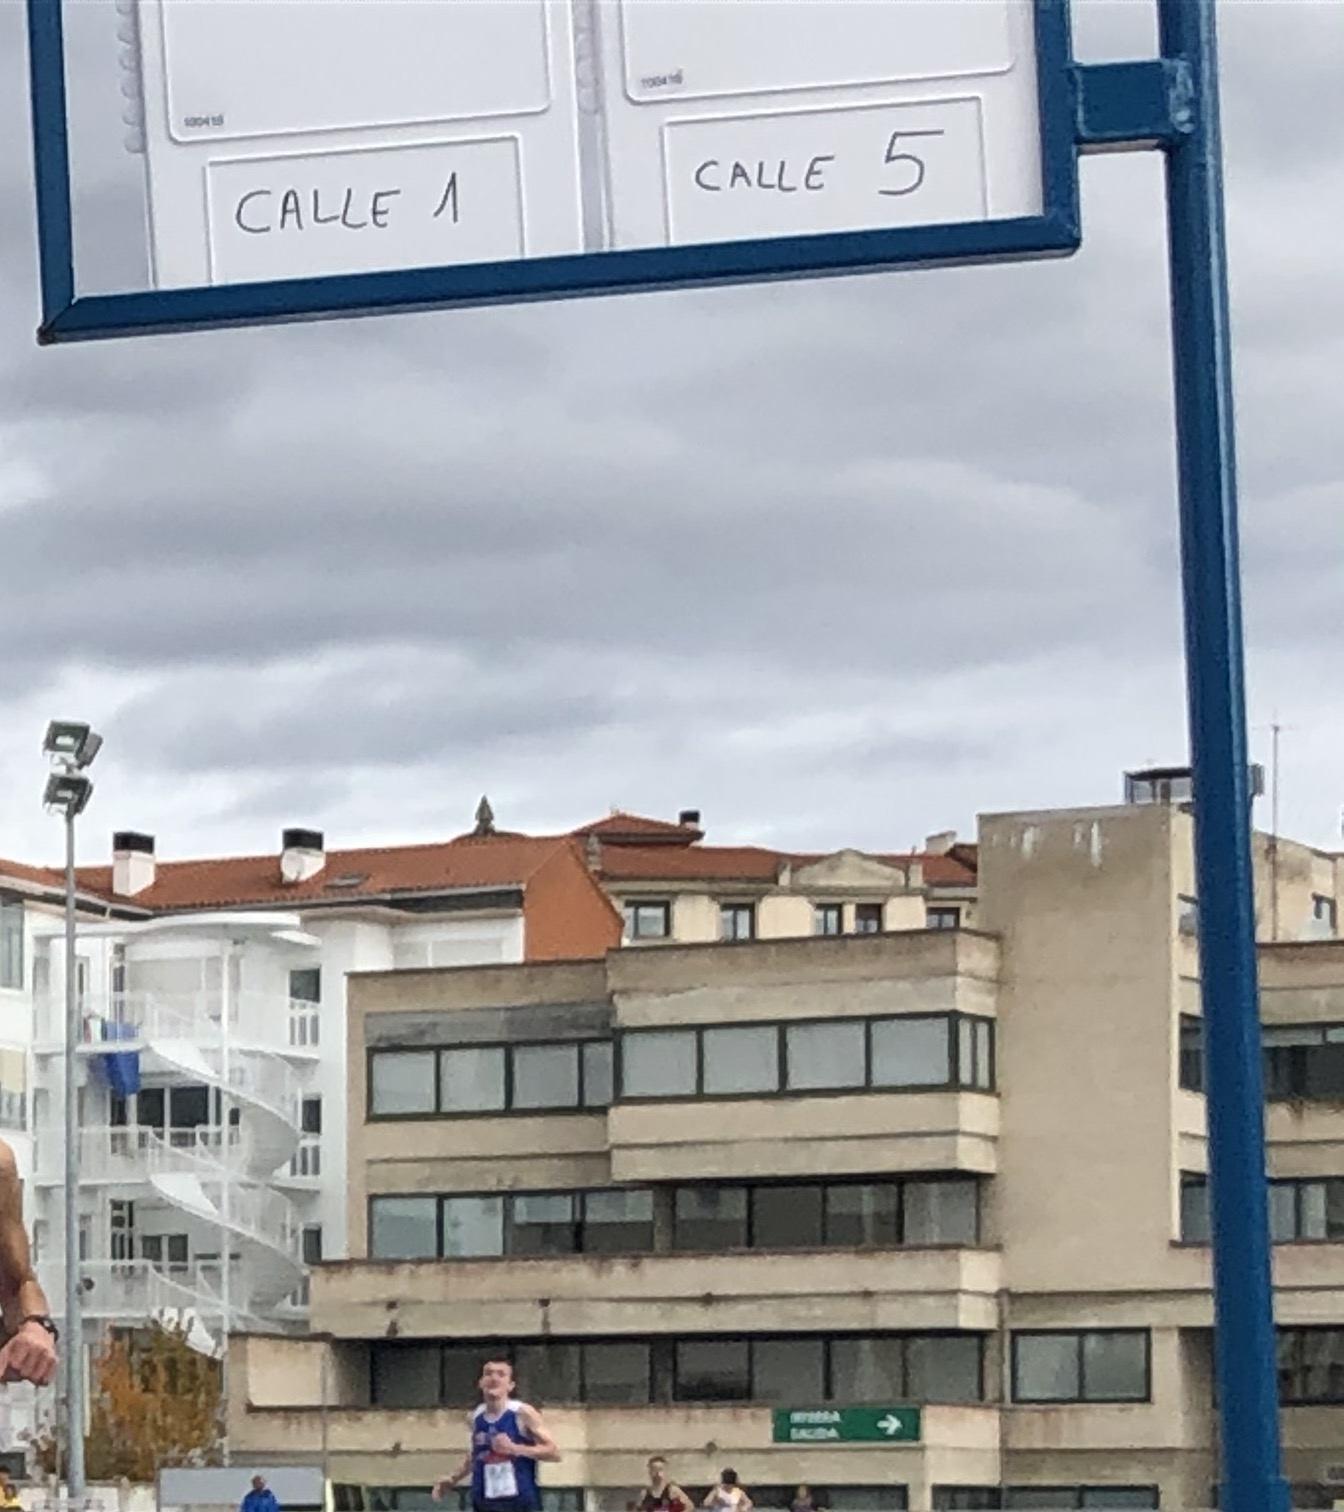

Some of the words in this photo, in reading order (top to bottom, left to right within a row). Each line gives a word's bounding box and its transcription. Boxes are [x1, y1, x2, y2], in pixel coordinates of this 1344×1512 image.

[694, 154, 836, 192] CALLE
[878, 128, 945, 196] 5
[235, 187, 402, 233] CALLE
[433, 171, 459, 224] 1
